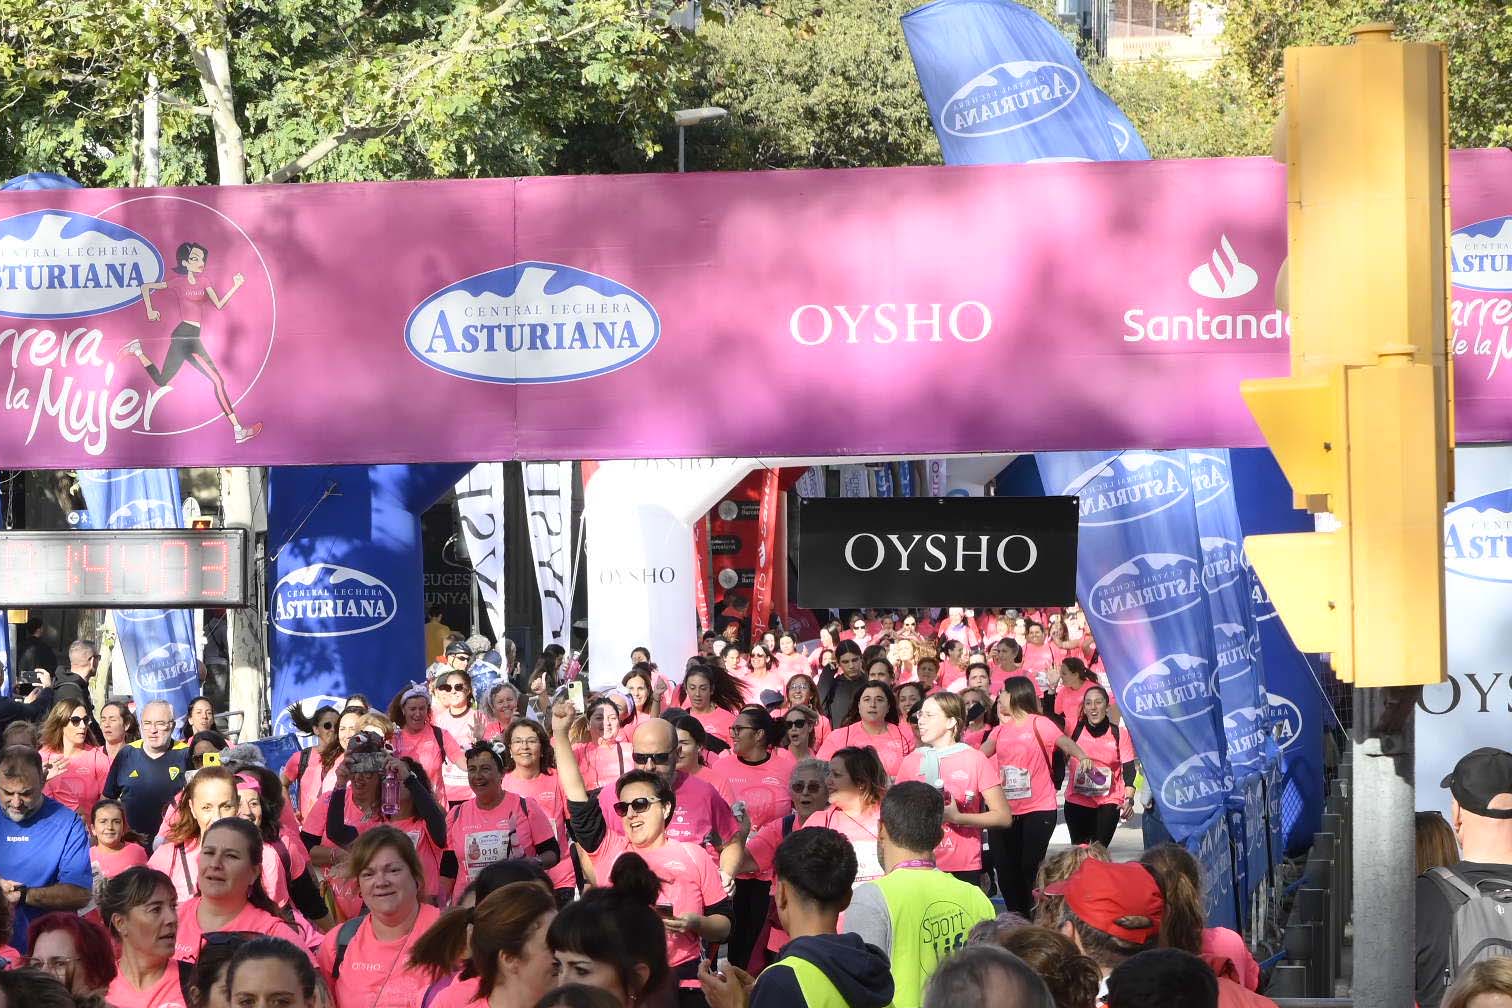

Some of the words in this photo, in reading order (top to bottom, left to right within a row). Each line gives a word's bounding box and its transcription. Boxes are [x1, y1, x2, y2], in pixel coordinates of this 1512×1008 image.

[66, 245, 140, 256] LECHERA
[464, 303, 543, 317] CENTRAL
[550, 301, 632, 315] LECHERA
[789, 300, 993, 345] OYSHO
[425, 309, 640, 354] ASTURIANA
[4, 368, 30, 410] la
[25, 362, 175, 456] Mujer
[844, 532, 1038, 574] OYSHO
[275, 593, 388, 620] ASTURIANA
[287, 588, 329, 598] CENTRAL
[334, 588, 383, 597] LECHERA
[922, 911, 965, 943] Sport
